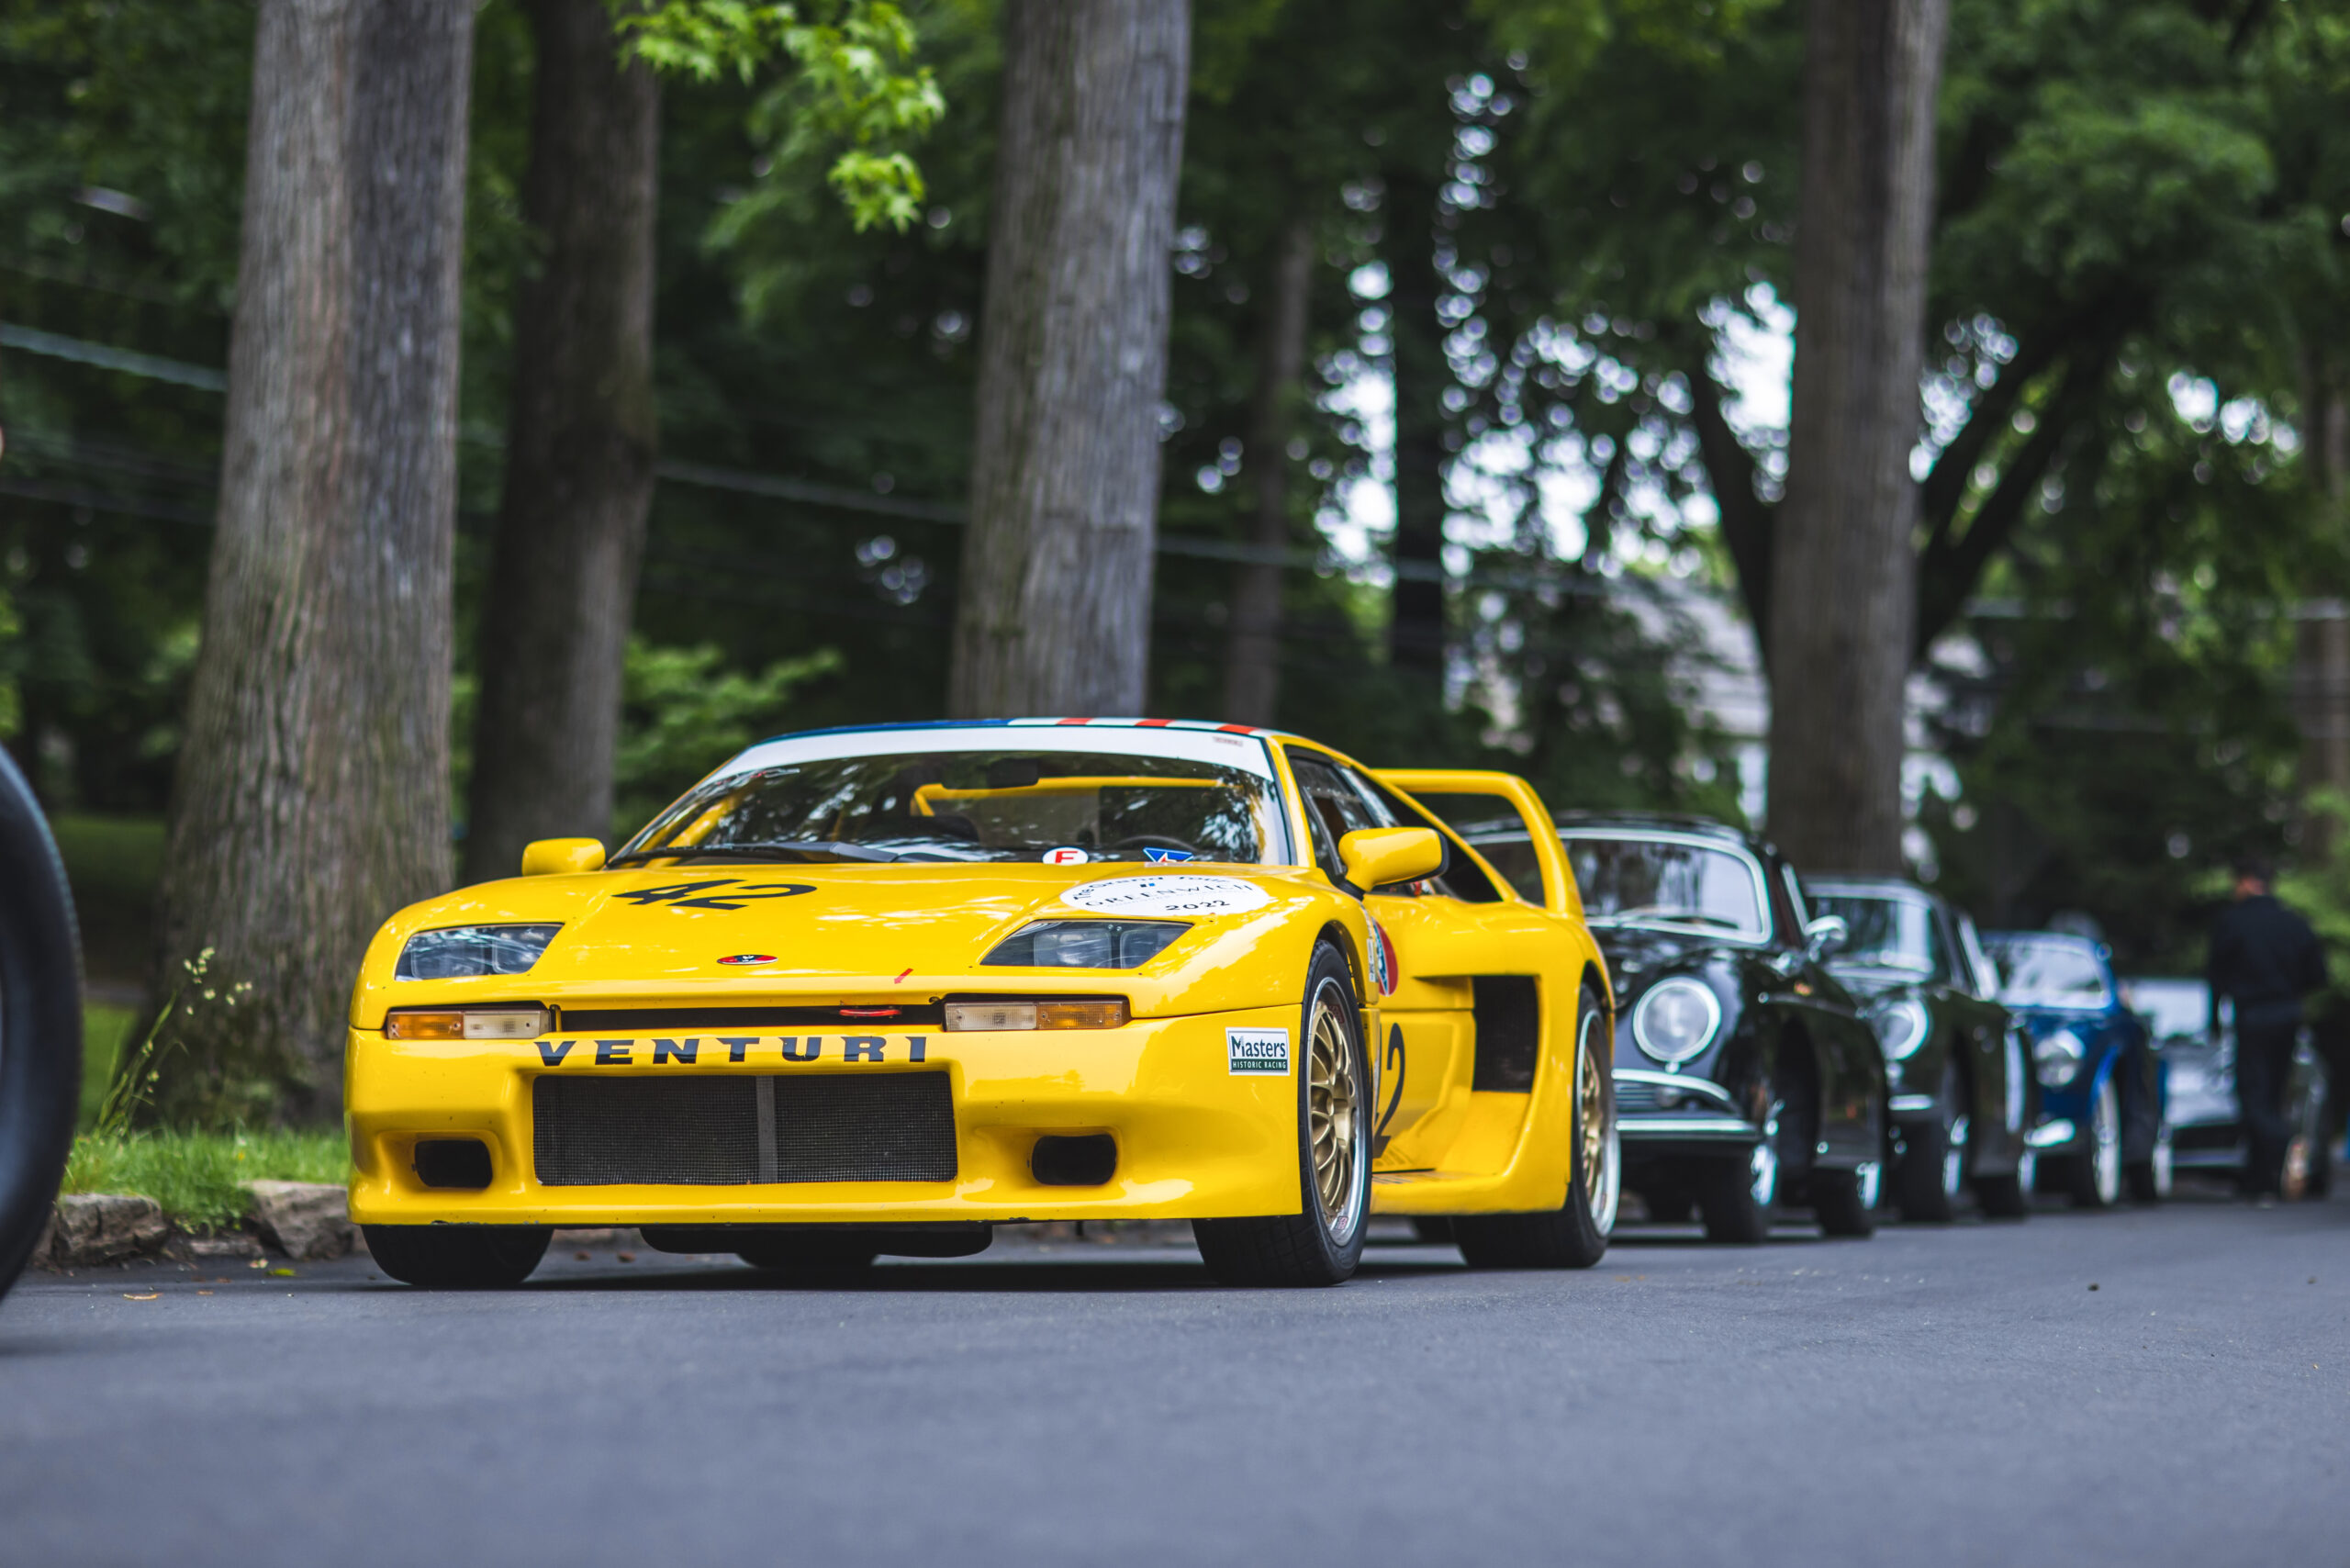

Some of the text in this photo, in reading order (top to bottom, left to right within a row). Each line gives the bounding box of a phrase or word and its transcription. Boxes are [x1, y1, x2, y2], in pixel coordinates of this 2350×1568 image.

[1055, 850, 1078, 864] F
[610, 879, 818, 911] 42
[1085, 884, 1253, 907] GREENWICH
[1165, 900, 1230, 911] 2022
[534, 1036, 926, 1067] VENTURI
[1231, 1035, 1286, 1058] Masters
[1232, 1060, 1286, 1070] HISTORIC RACING
